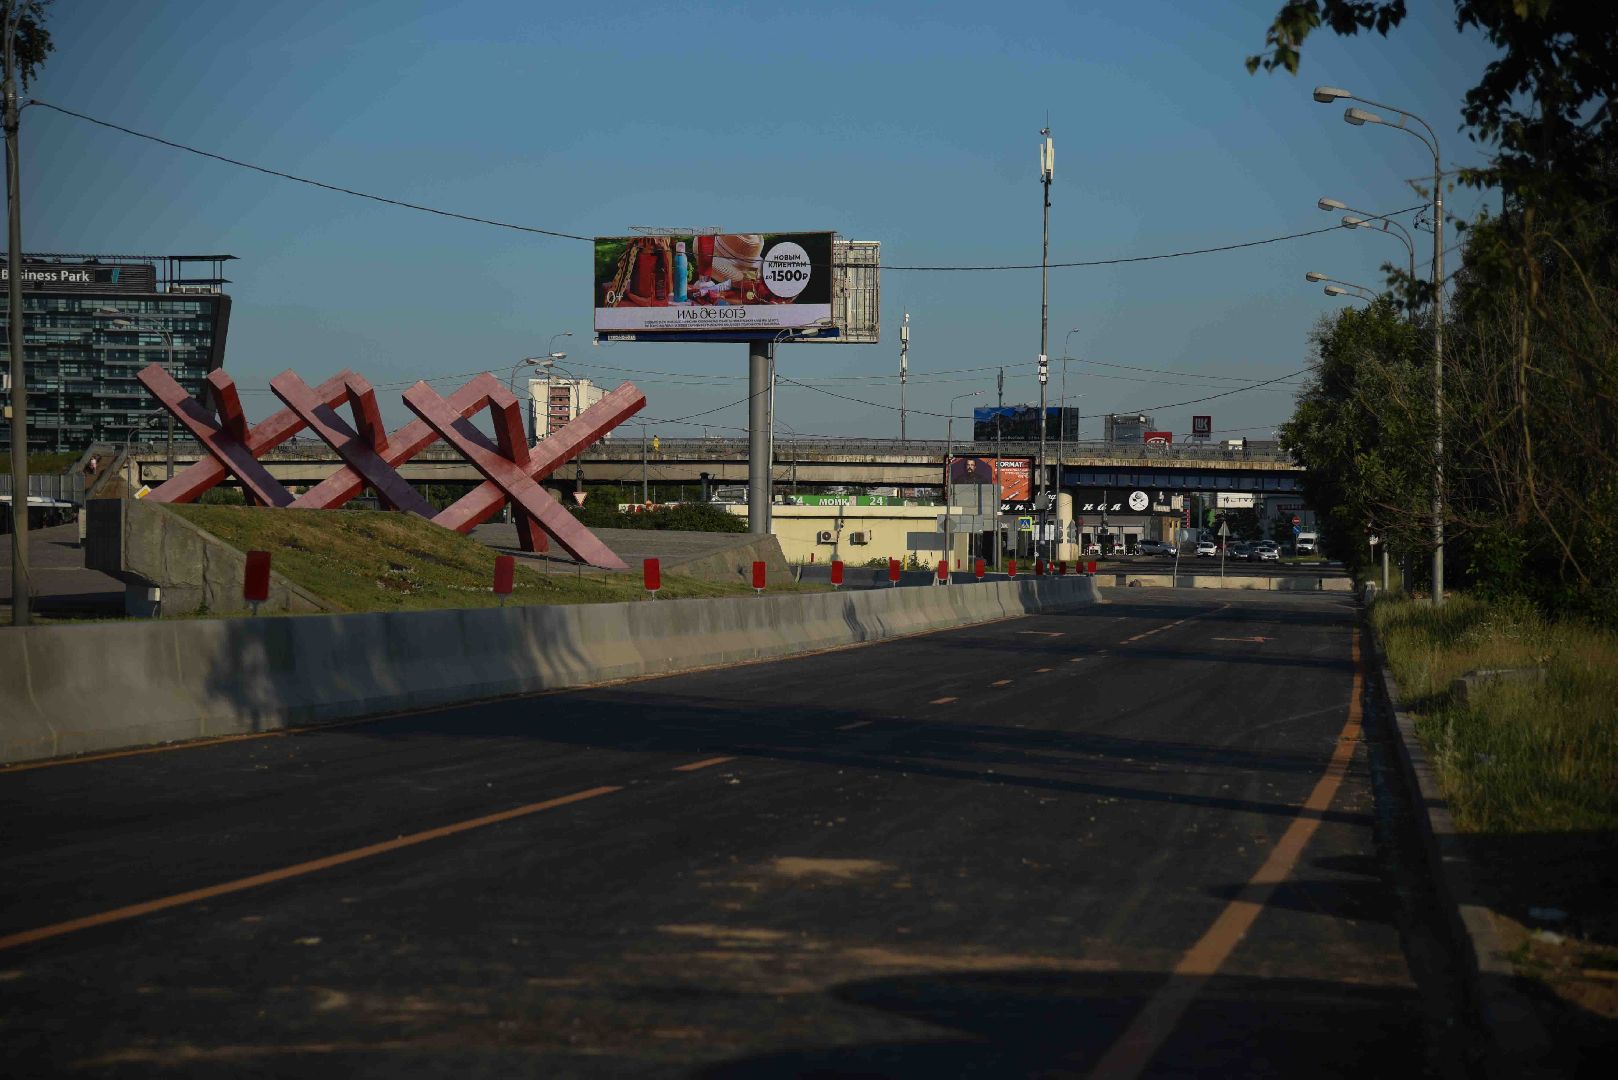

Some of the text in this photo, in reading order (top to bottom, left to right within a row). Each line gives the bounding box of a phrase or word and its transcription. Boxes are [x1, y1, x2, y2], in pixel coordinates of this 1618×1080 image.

[1, 269, 90, 282] Bsiness Park
[607, 291, 624, 304] 0+
[819, 495, 850, 506] МОЙК
[869, 496, 884, 506] 24
